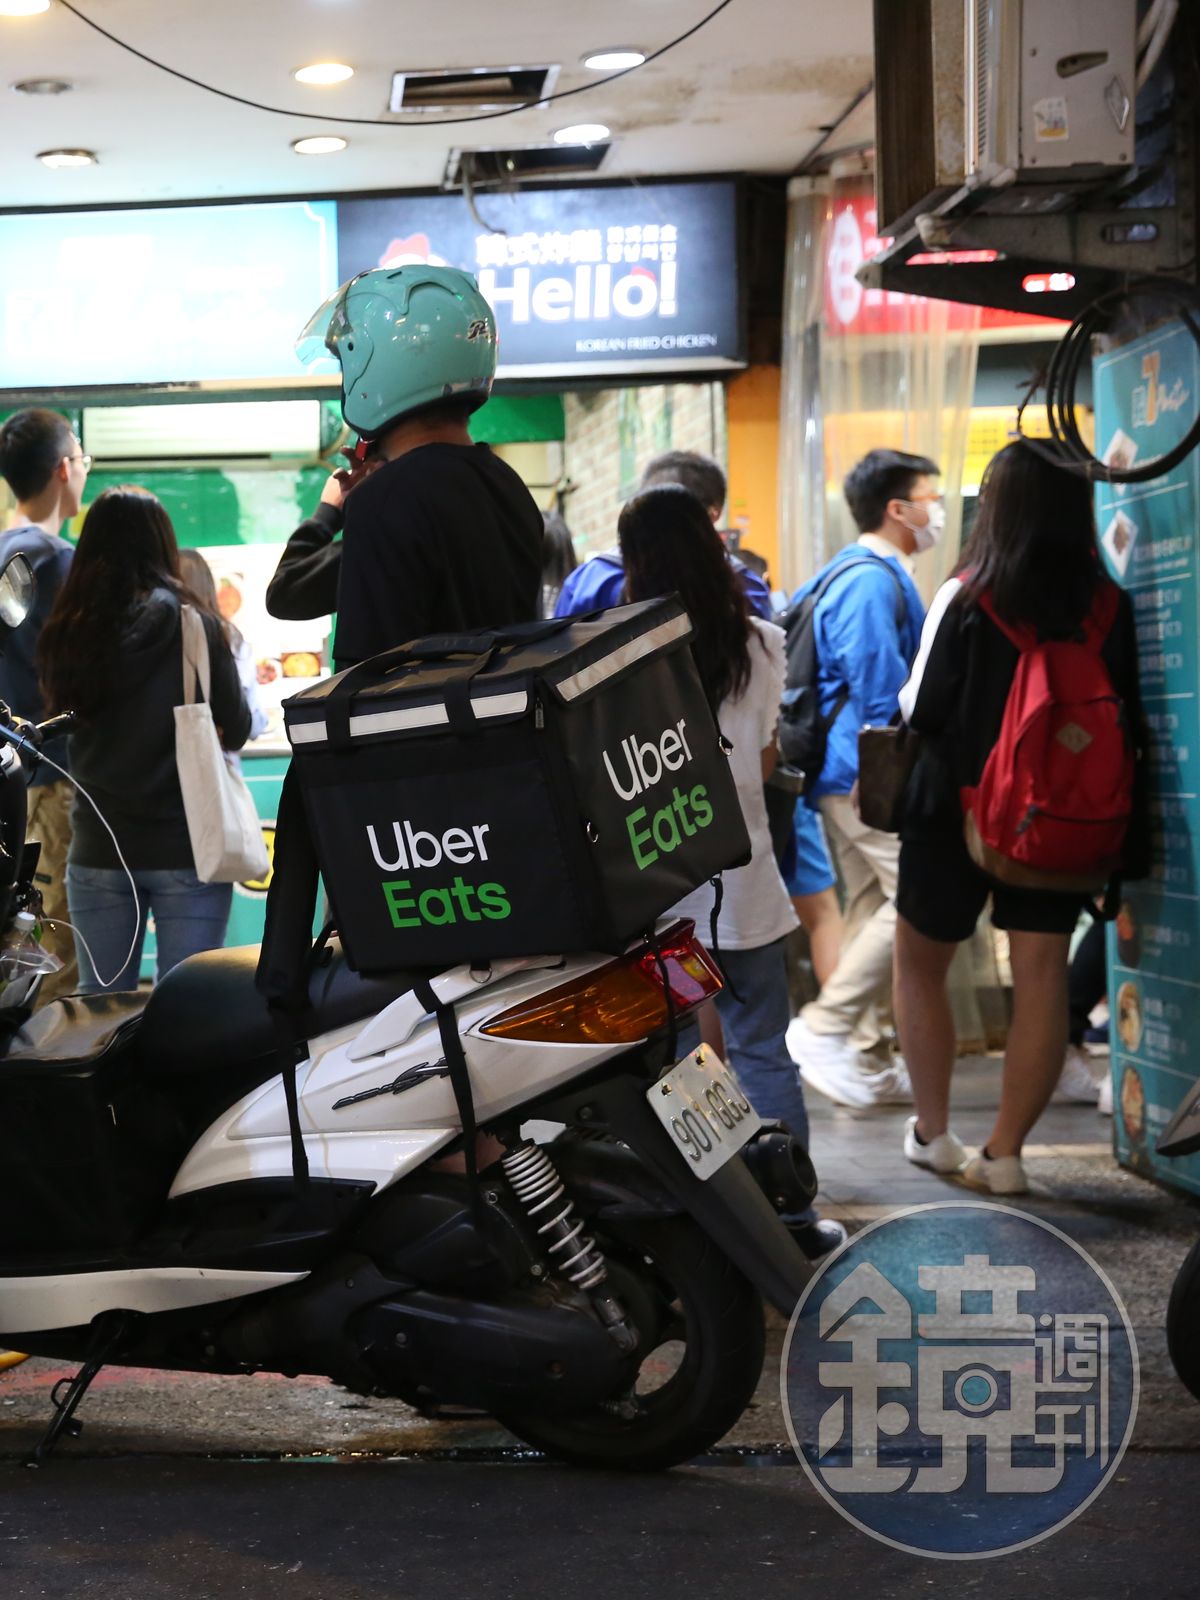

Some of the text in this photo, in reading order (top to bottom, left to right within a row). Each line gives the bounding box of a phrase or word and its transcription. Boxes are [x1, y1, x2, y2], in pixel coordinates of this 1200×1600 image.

[478, 260, 678, 322] Hello!
[602, 718, 693, 801] Uber
[366, 820, 490, 872] Uber
[625, 784, 714, 871] Eats
[382, 877, 512, 928] Eats
